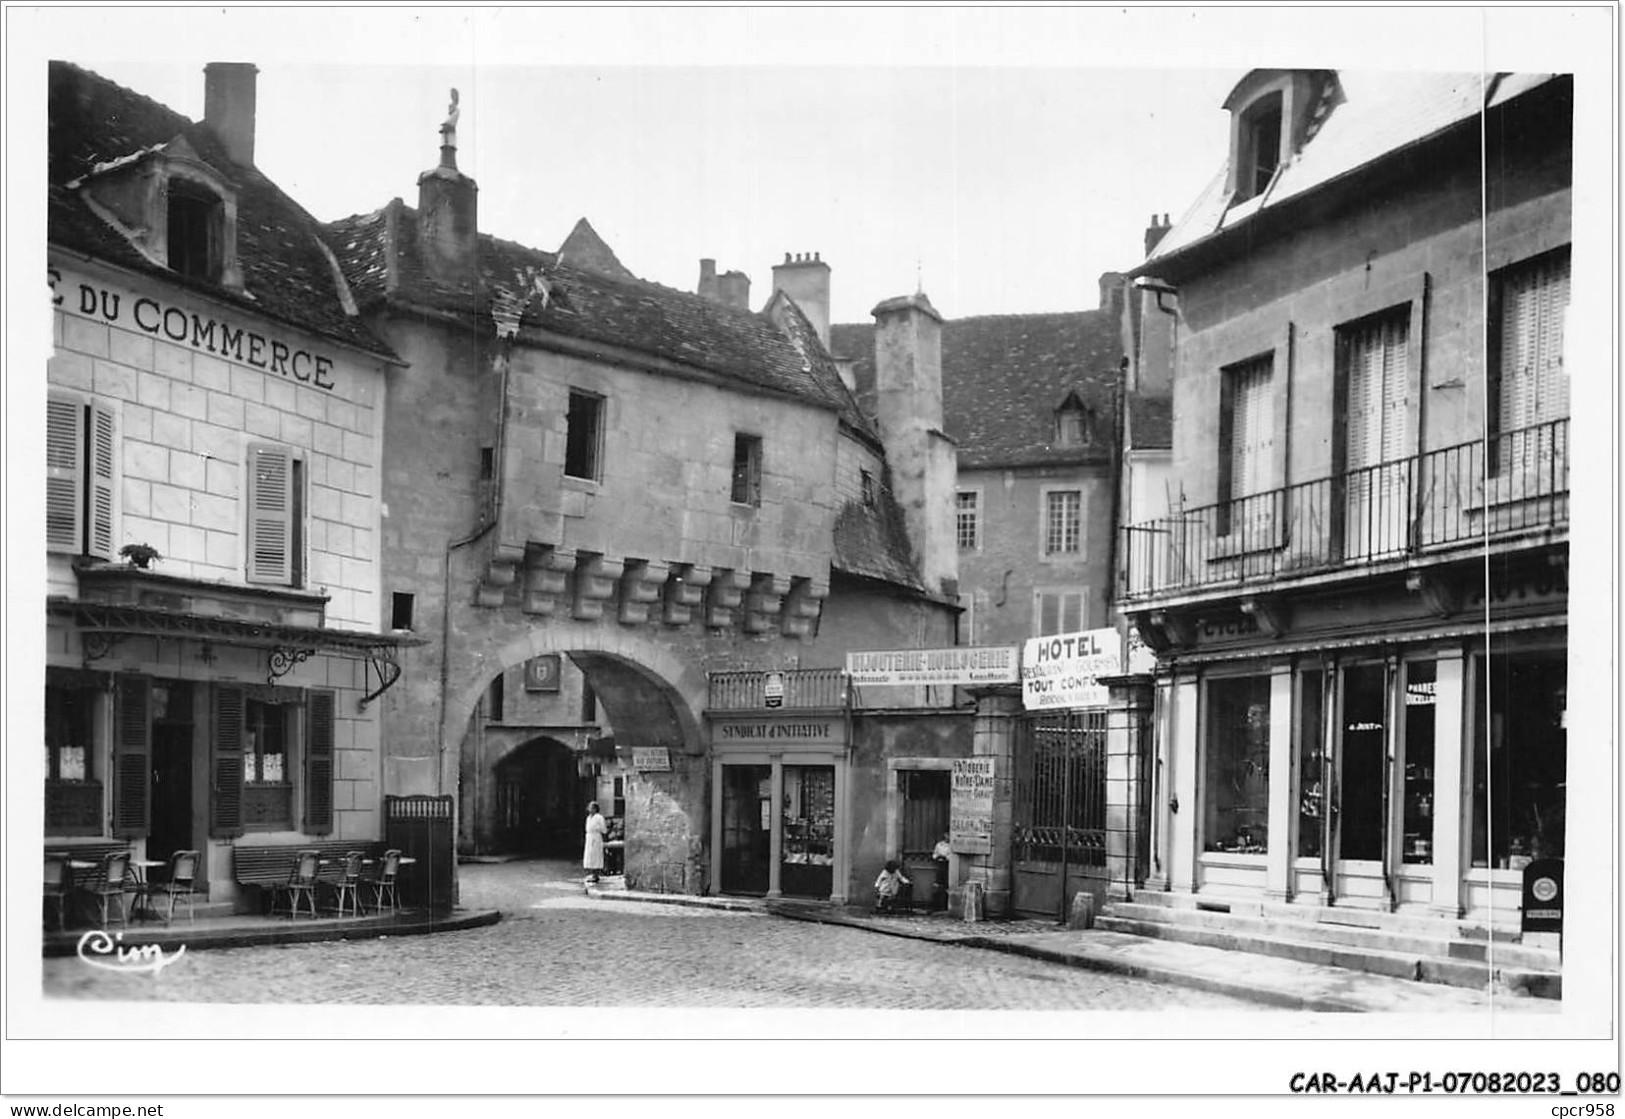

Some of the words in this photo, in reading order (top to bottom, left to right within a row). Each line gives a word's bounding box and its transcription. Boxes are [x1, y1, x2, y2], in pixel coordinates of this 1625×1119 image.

[47, 267, 64, 307] E
[79, 284, 121, 322] DU
[133, 298, 335, 390] COMMERCE
[1038, 635, 1102, 663] HOTEL
[1028, 680, 1054, 694] TOUT
[1061, 674, 1097, 690] CONFO
[1408, 682, 1437, 694] PHARES
[723, 723, 766, 739] SYNDICAT
